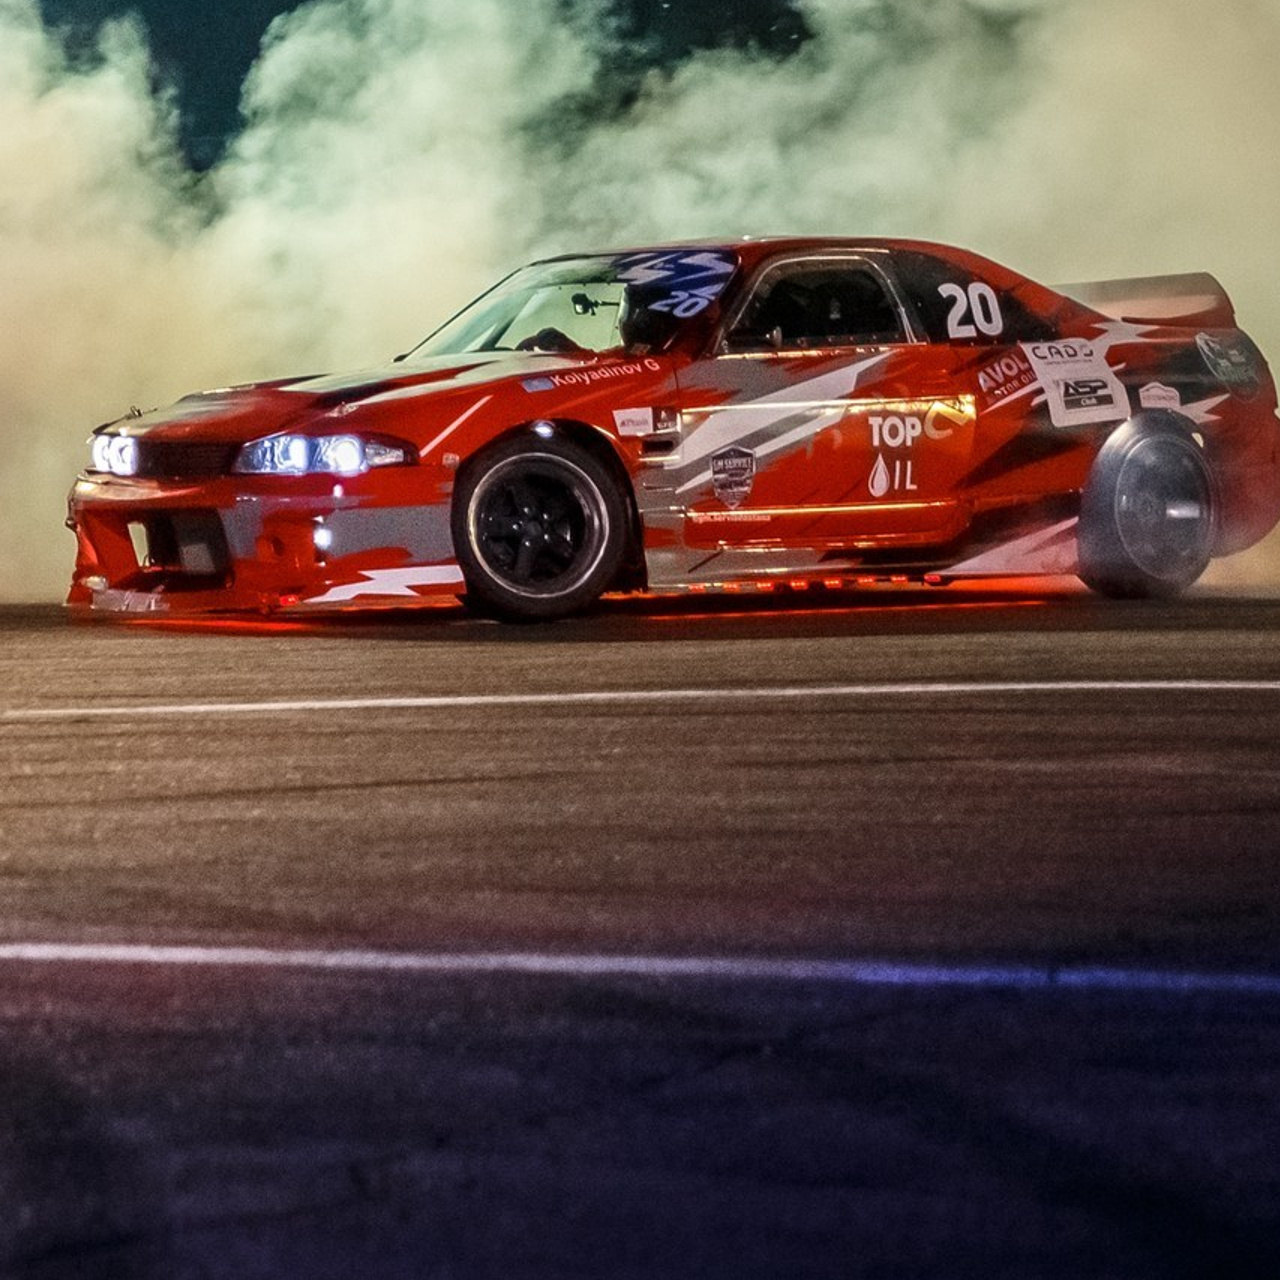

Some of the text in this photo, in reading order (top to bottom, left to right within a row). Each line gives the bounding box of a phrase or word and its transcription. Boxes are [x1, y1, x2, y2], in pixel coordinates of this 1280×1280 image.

[648, 289, 710, 318] 20
[937, 281, 1004, 339] 20
[550, 358, 660, 386] Kolyadinov G
[1064, 378, 1109, 398] ASP
[868, 416, 922, 448] TOP
